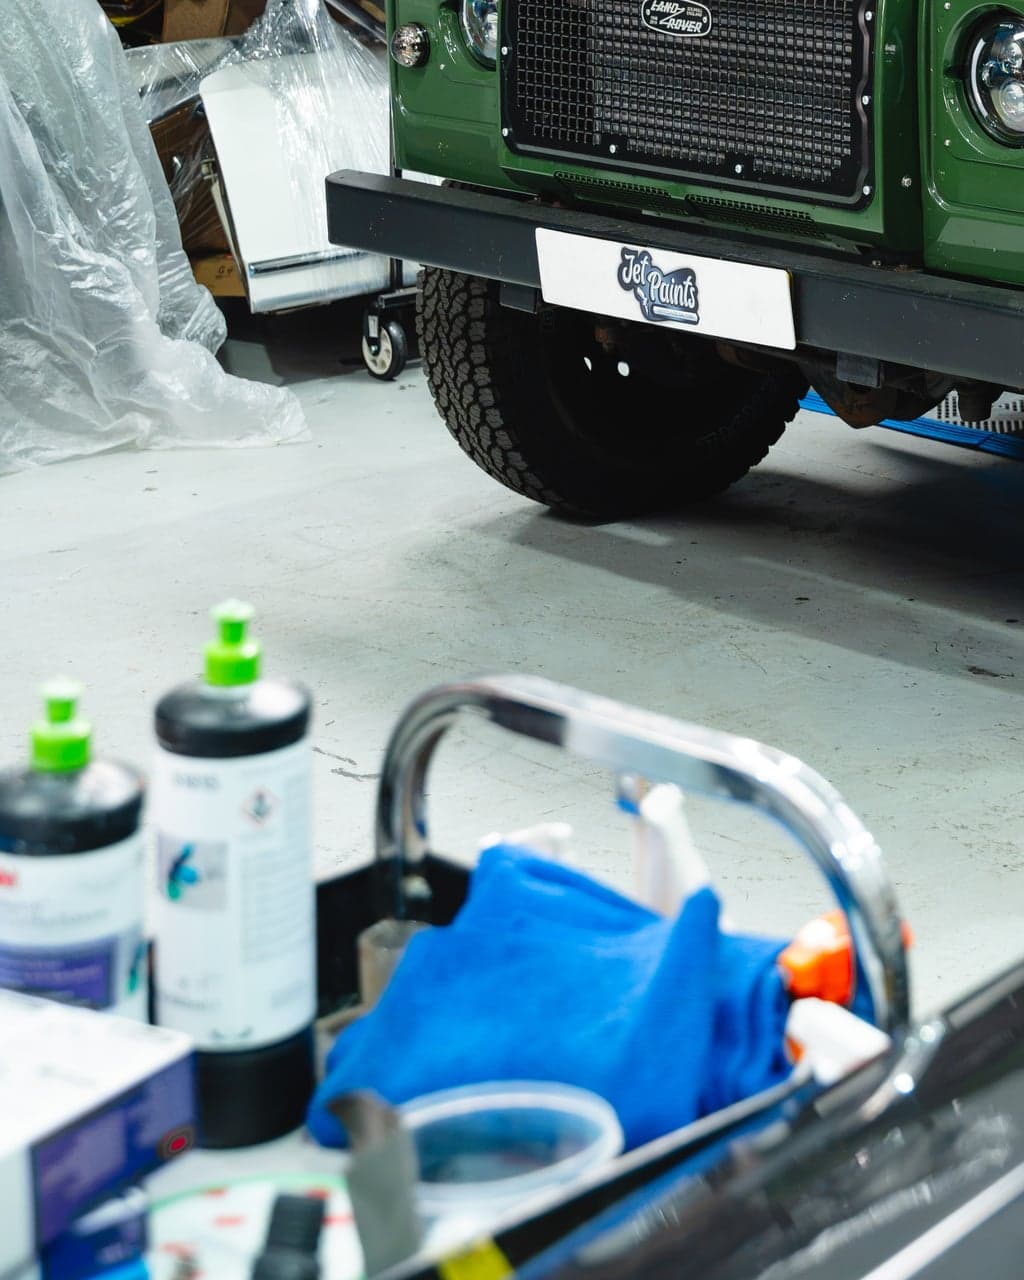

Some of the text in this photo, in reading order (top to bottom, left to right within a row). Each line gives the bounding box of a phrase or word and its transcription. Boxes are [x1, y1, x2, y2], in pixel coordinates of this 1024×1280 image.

[650, 0, 680, 13] LAND
[667, 18, 702, 33] ROVER
[622, 254, 648, 285] Jet
[648, 271, 695, 309] Paints
